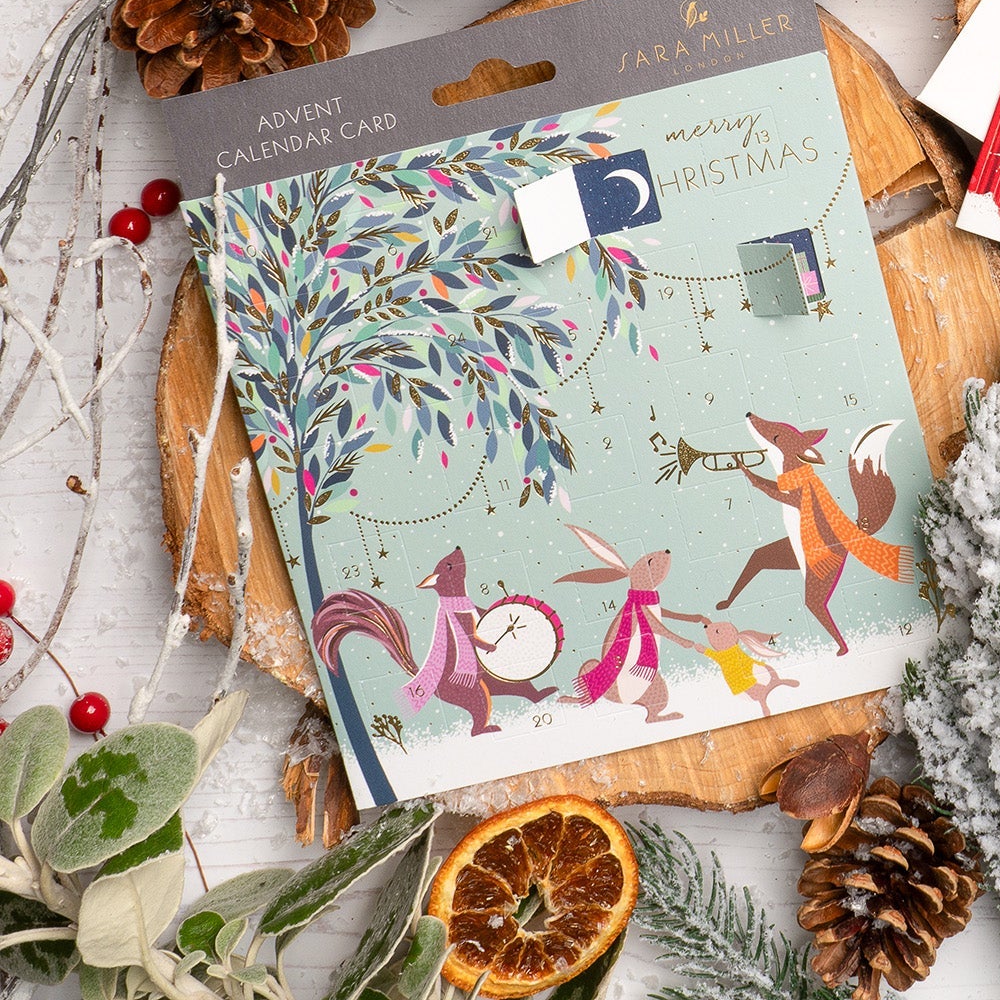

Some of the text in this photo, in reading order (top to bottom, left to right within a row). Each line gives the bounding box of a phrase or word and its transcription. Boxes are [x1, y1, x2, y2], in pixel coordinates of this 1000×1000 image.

[618, 14, 793, 73] SARA MILLER
[672, 51, 746, 76] LONDON
[257, 96, 343, 133] ADVENT
[665, 112, 763, 149] merry
[755, 131, 771, 144] 13
[216, 112, 398, 169] CALENDAR CARD
[656, 136, 820, 198] HRISTMAS
[482, 226, 498, 240] 21
[387, 243, 398, 257] 6
[657, 286, 674, 301] 19
[447, 332, 467, 346] 24
[567, 328, 577, 341] 5
[704, 392, 714, 405] 9
[843, 393, 858, 407] 15
[602, 437, 613, 450] 2
[498, 478, 510, 491] 11
[724, 498, 733, 510] 7
[341, 565, 361, 580] 23
[479, 582, 490, 596] 8
[601, 599, 617, 613] 14
[898, 623, 913, 637] 12
[767, 635, 777, 647] 4
[408, 684, 425, 698] 16
[533, 713, 553, 728] 20
